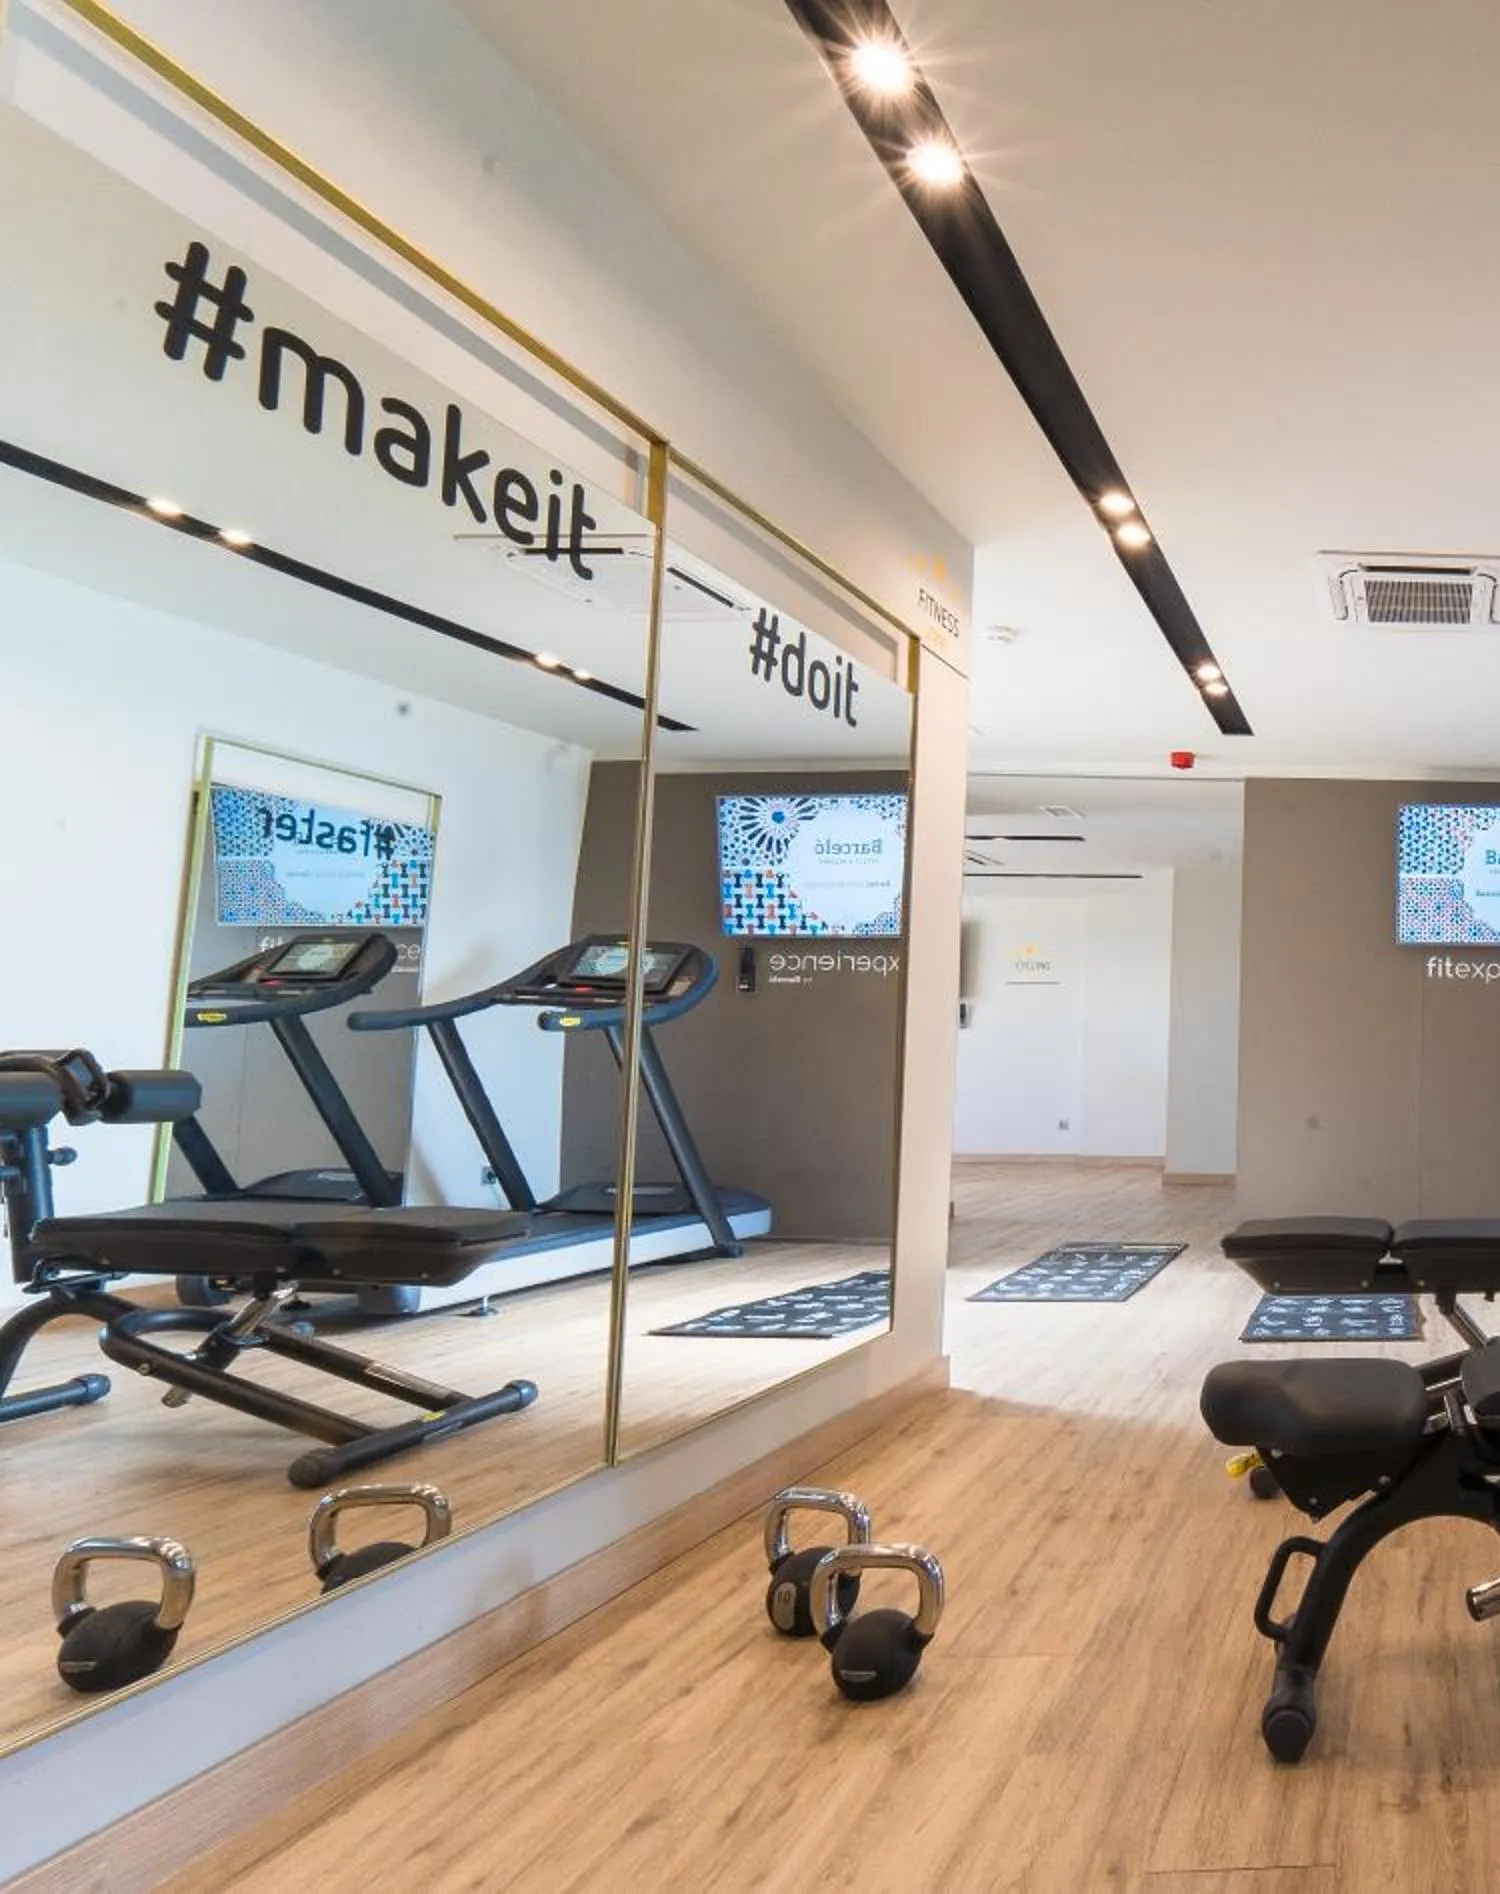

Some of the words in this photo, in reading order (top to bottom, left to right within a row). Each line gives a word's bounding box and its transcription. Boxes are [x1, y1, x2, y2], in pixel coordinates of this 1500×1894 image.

[155, 242, 597, 580] #makeit
[750, 606, 860, 728] #doit
[918, 588, 960, 638] FITNESS
